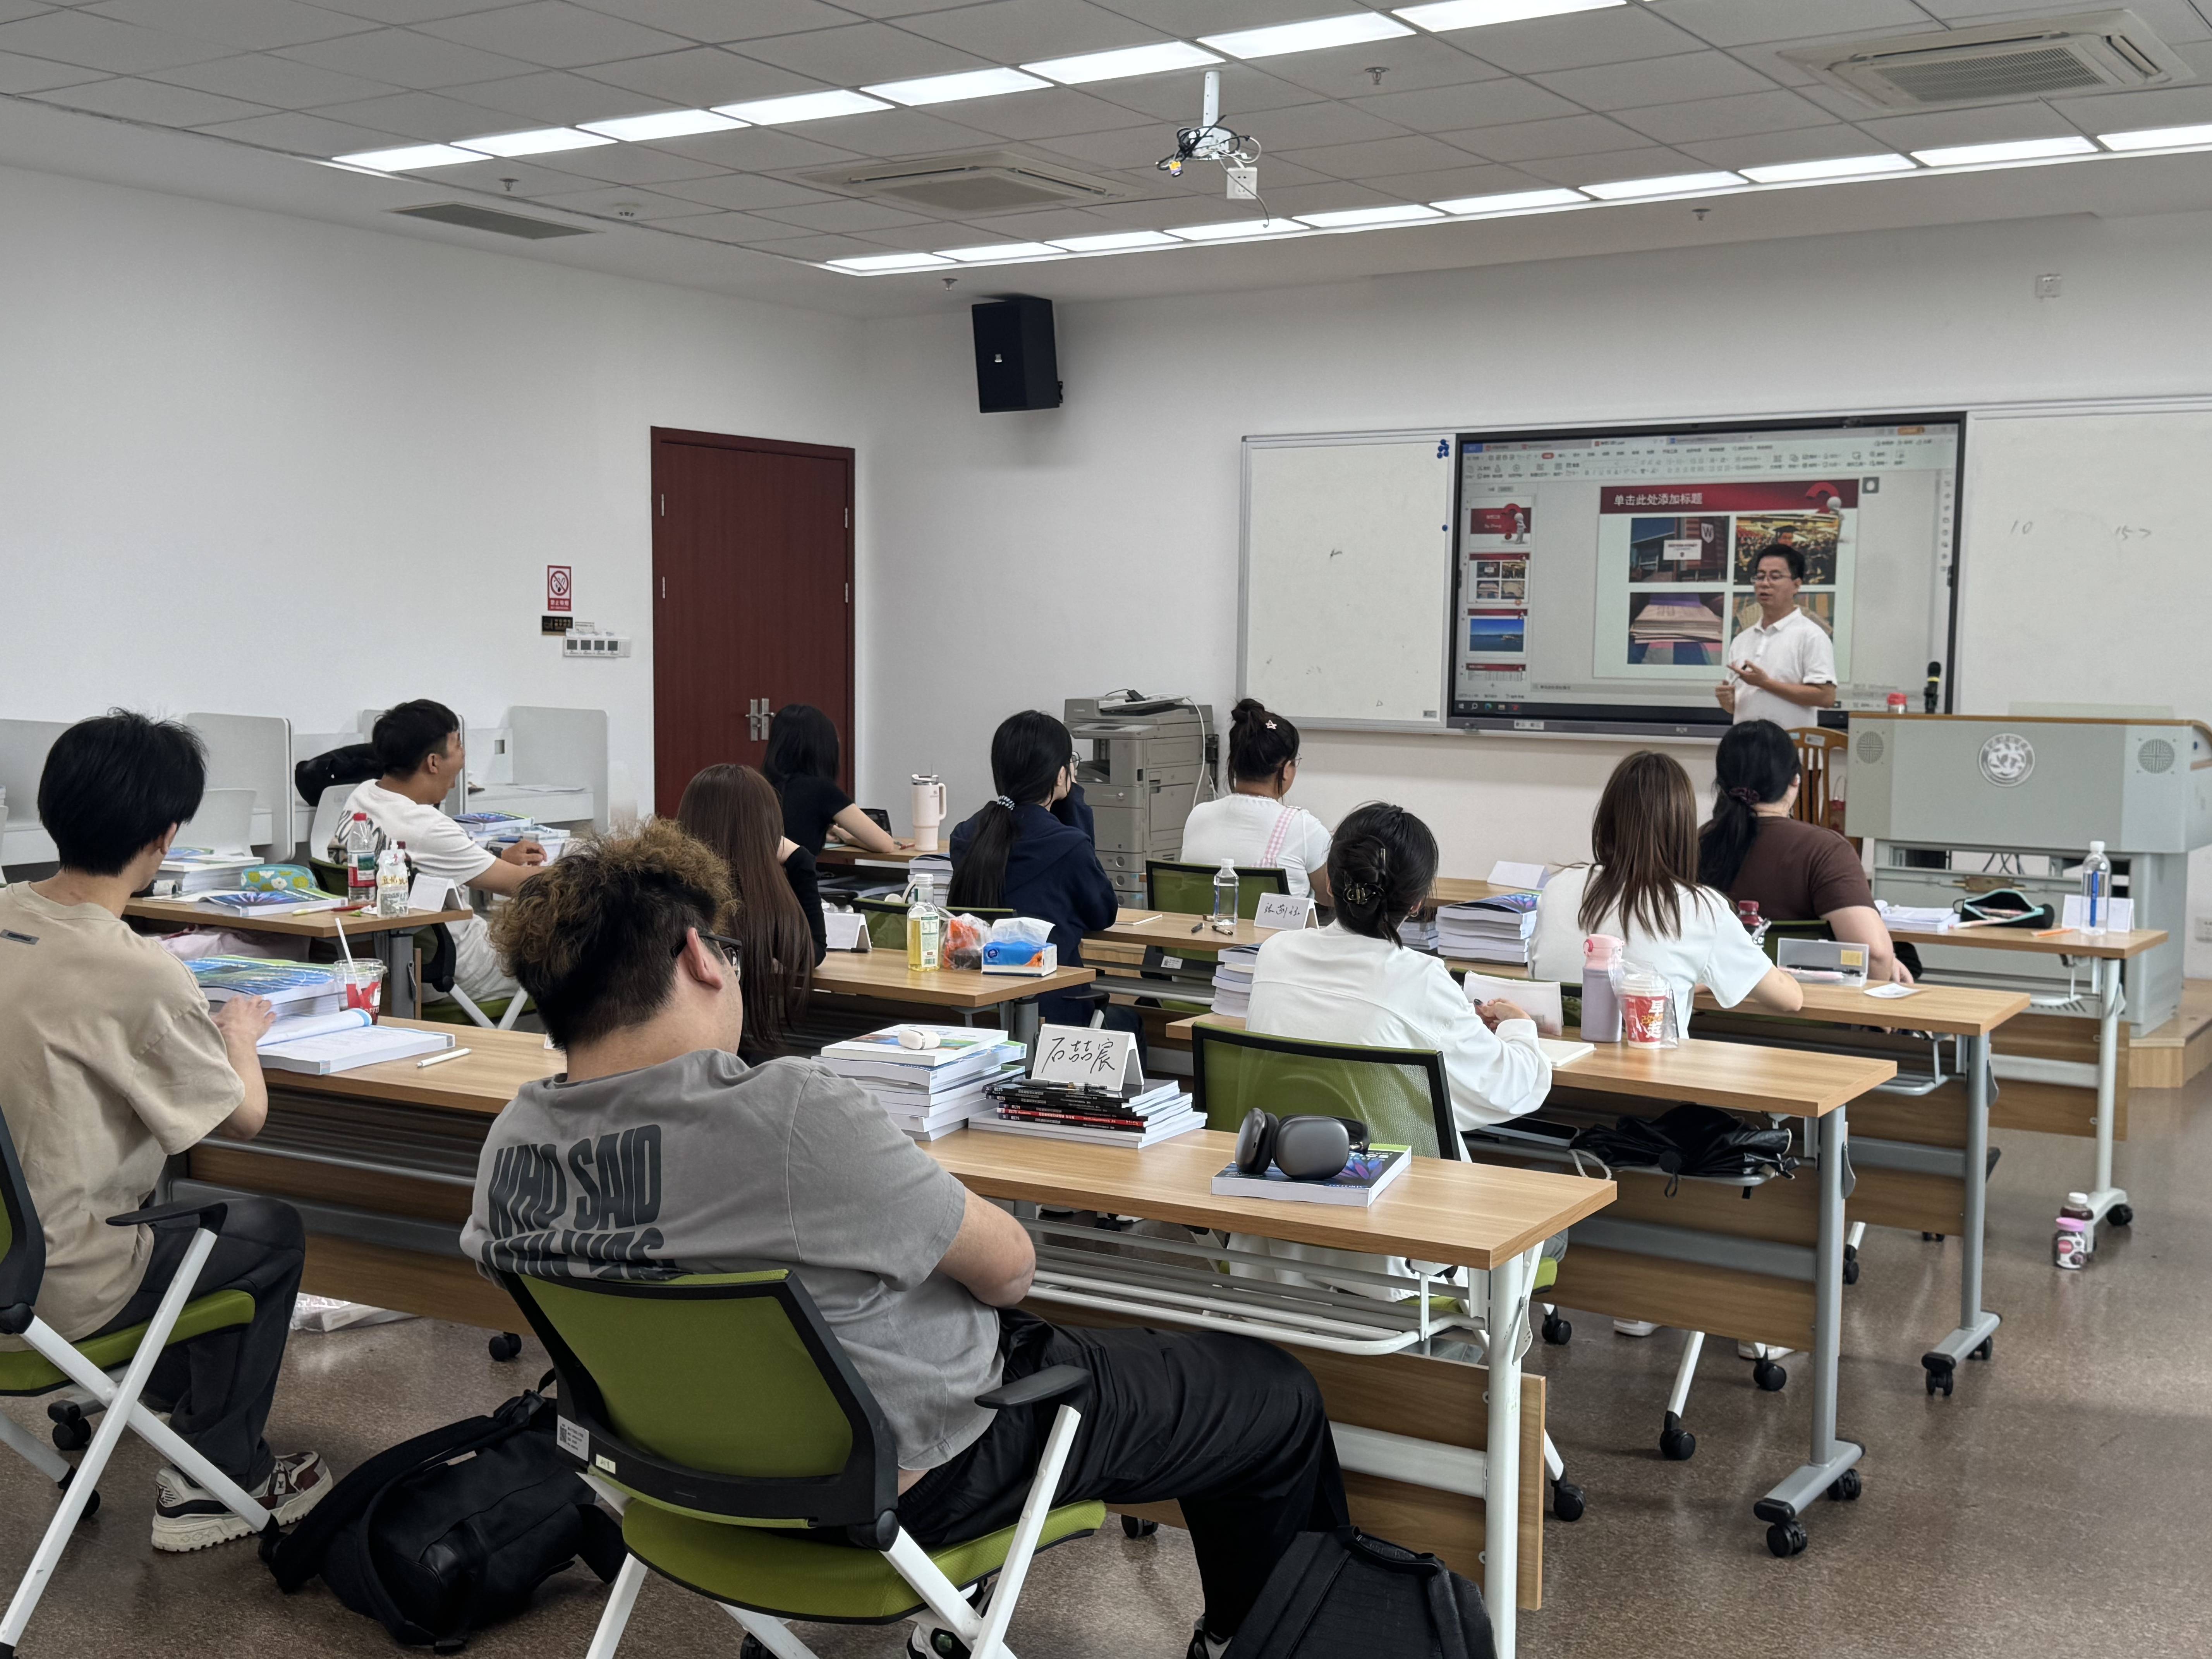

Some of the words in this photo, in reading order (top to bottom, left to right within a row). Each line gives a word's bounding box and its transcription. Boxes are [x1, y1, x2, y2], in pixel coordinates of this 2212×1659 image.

[1614, 493, 1703, 506] 单击此处添加标题
[488, 1143, 567, 1240] WHO
[567, 1124, 662, 1231] SAID
